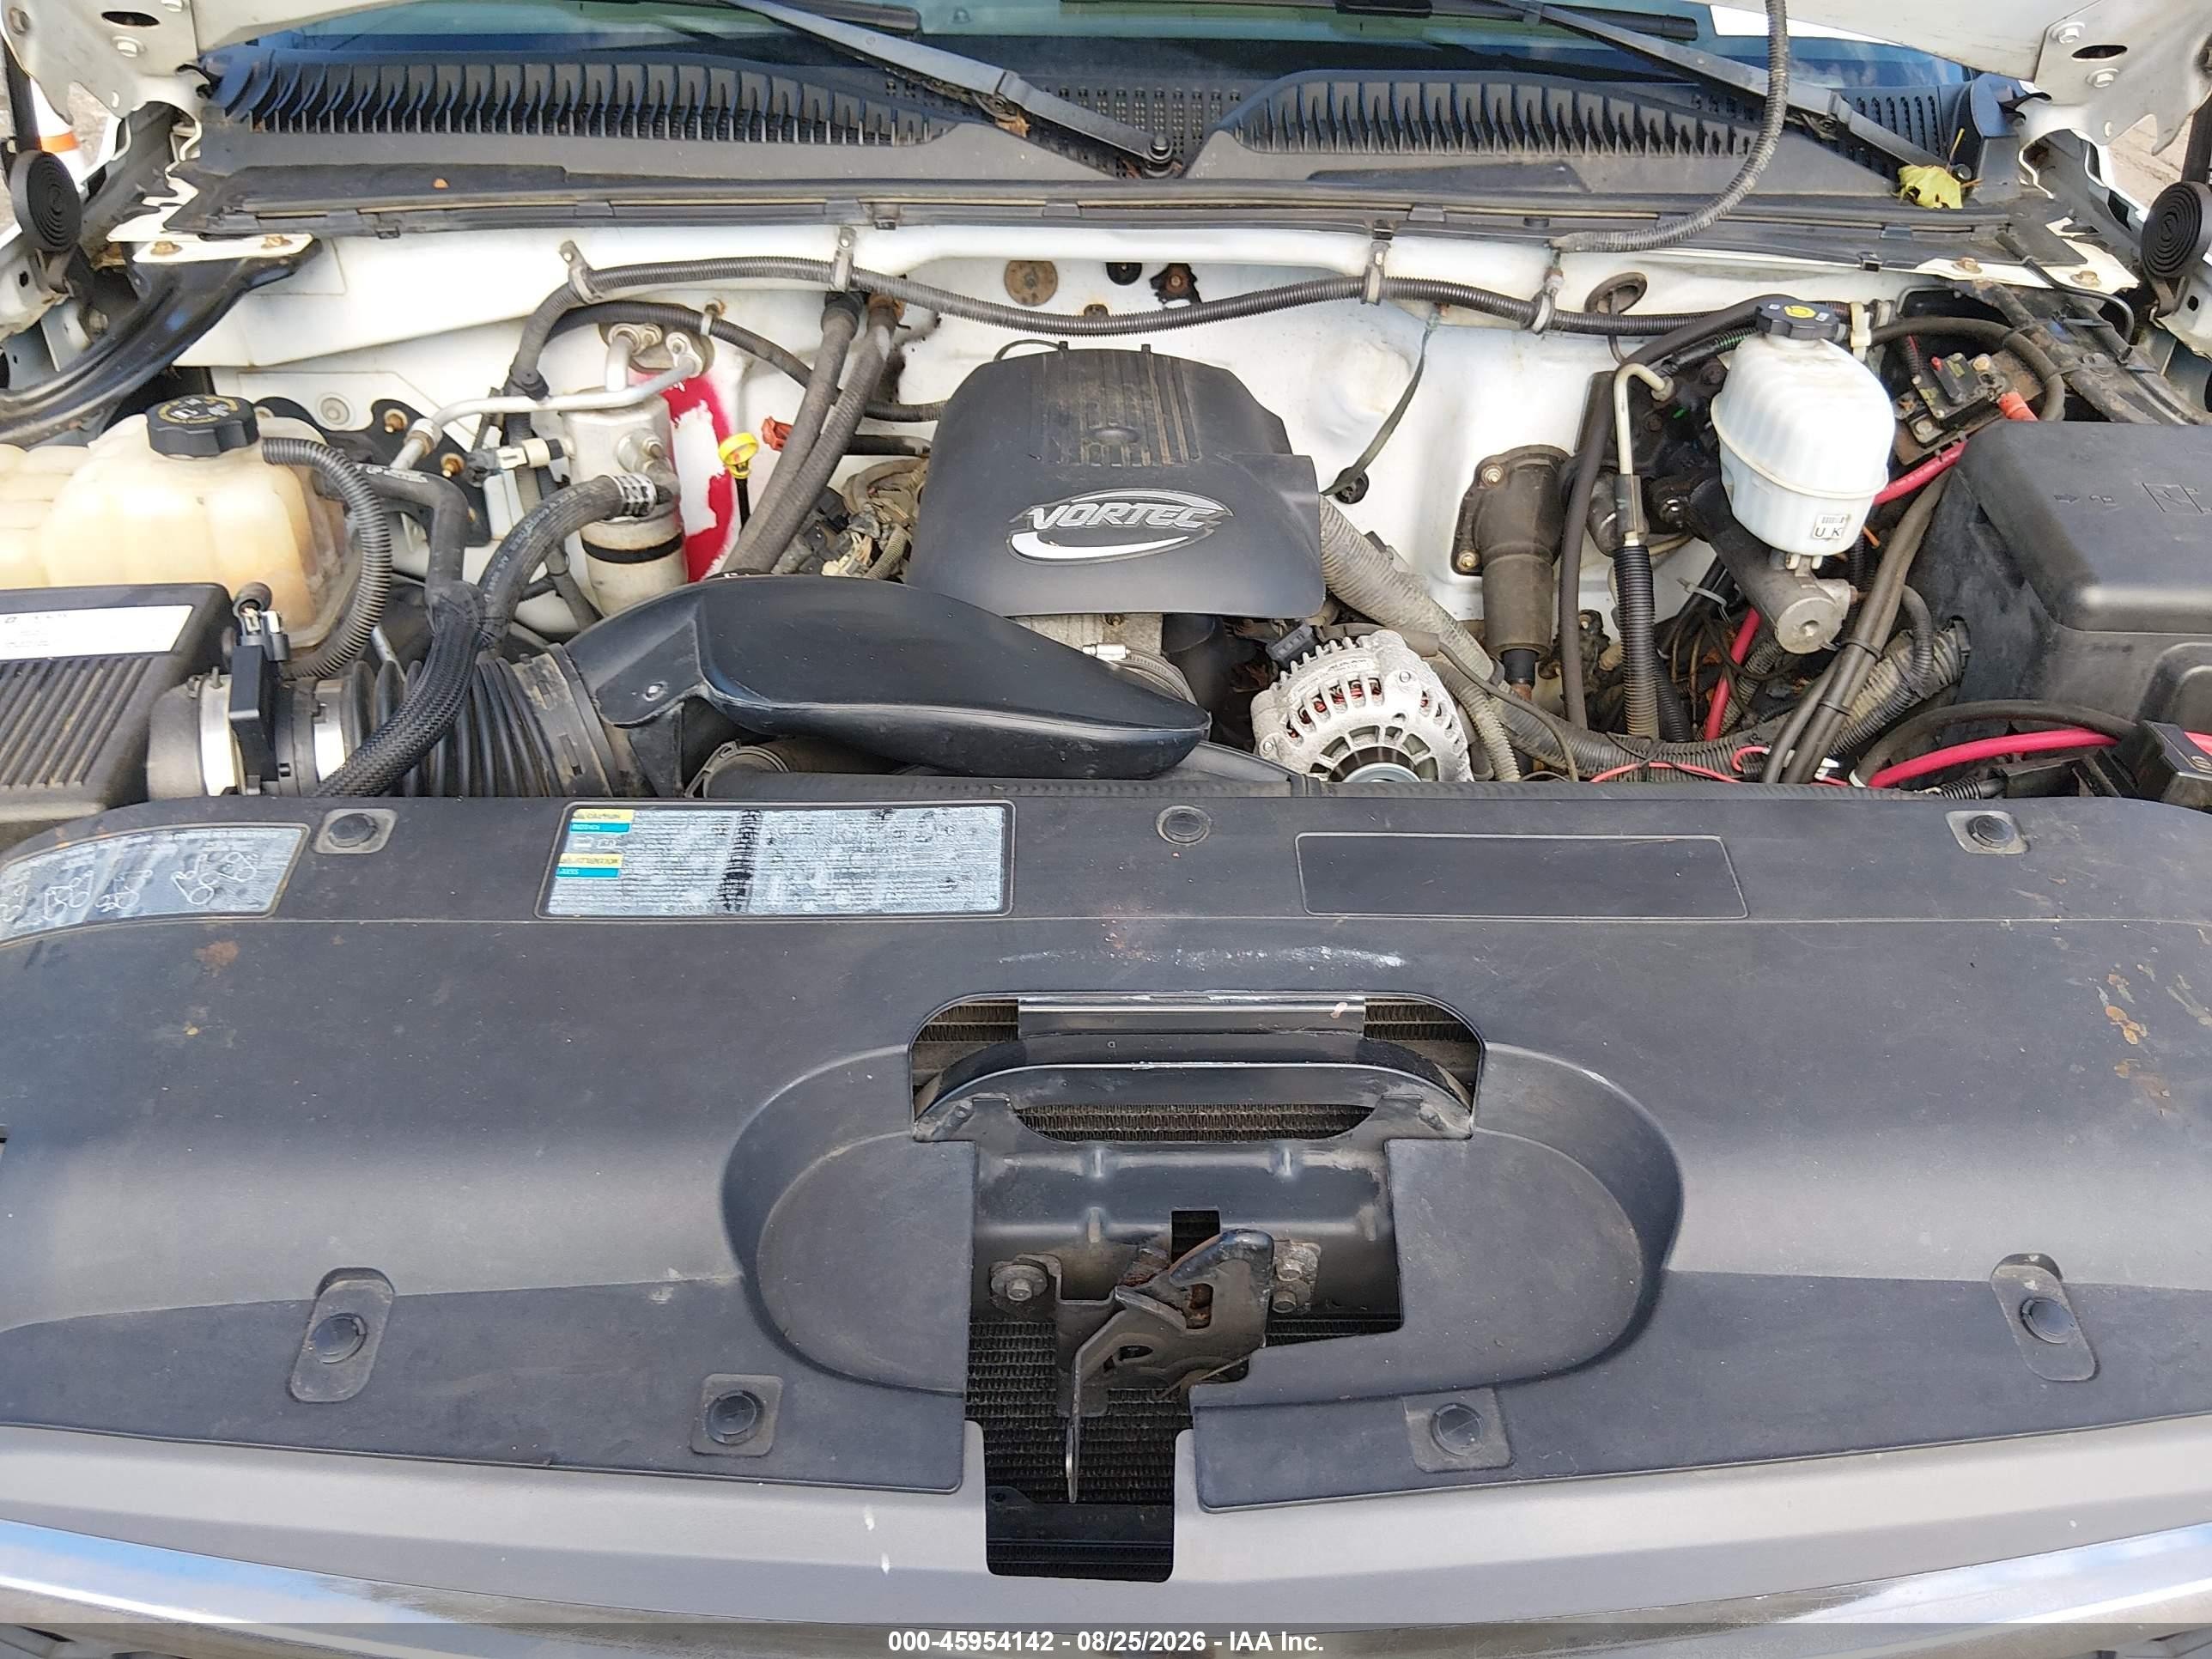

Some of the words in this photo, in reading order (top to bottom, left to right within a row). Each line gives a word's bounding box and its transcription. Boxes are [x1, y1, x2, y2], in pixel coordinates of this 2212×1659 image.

[1027, 503, 1216, 529] VORTEC
[1814, 527, 1826, 538] U
[1832, 527, 1843, 537] K
